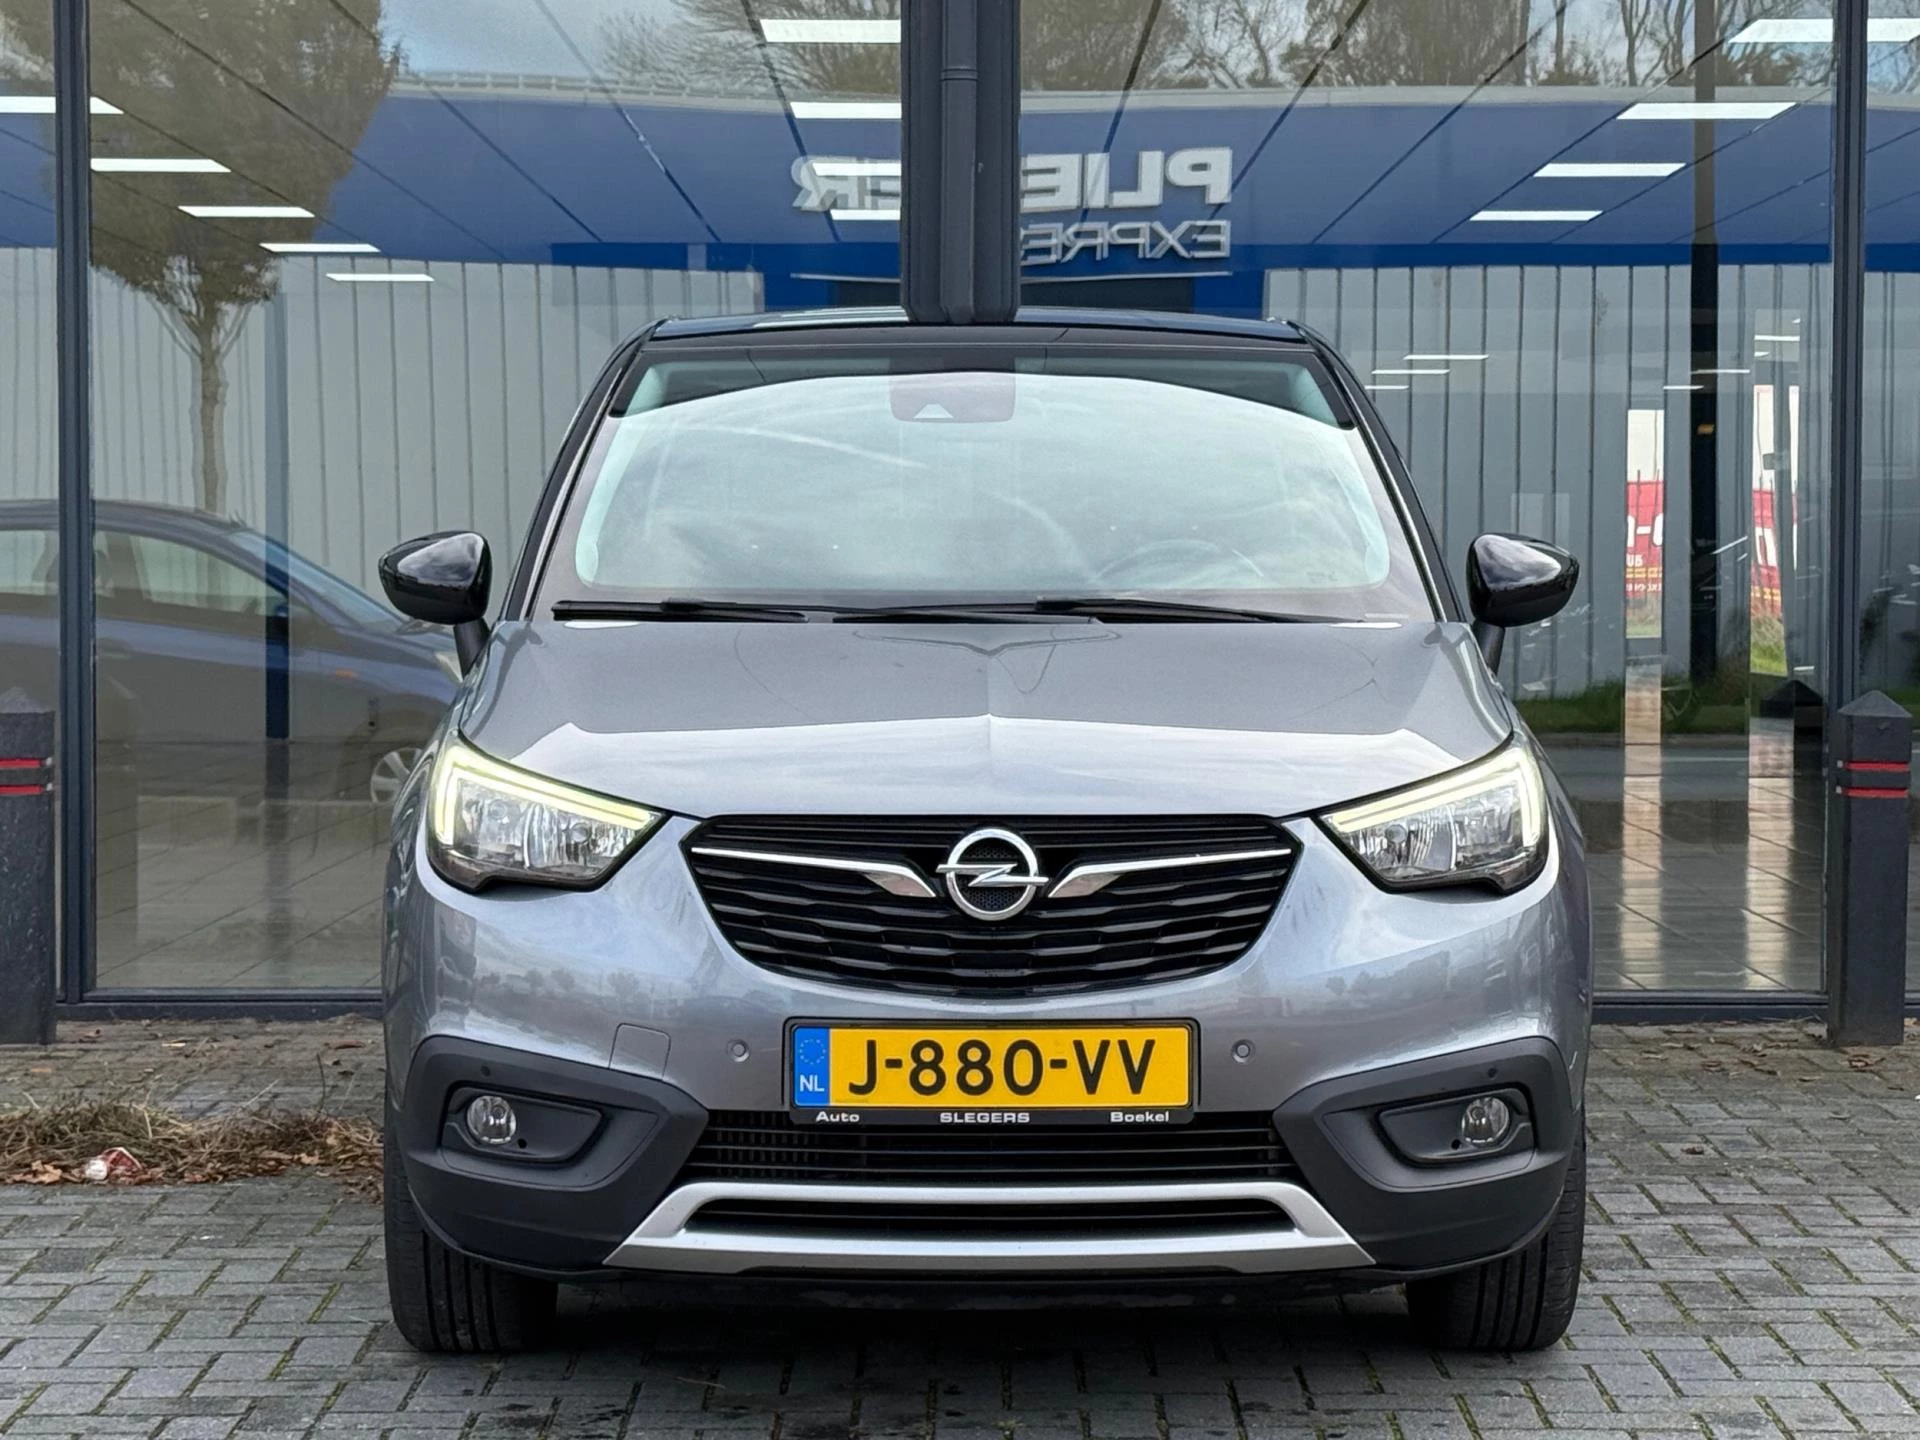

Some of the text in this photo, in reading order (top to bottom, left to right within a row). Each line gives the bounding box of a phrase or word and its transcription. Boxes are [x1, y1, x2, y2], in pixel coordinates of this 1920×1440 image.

[848, 1039, 1155, 1096] J-880-VV
[799, 1074, 825, 1092] NL
[815, 1111, 1170, 1124] Auto SLEGERS Boekel
